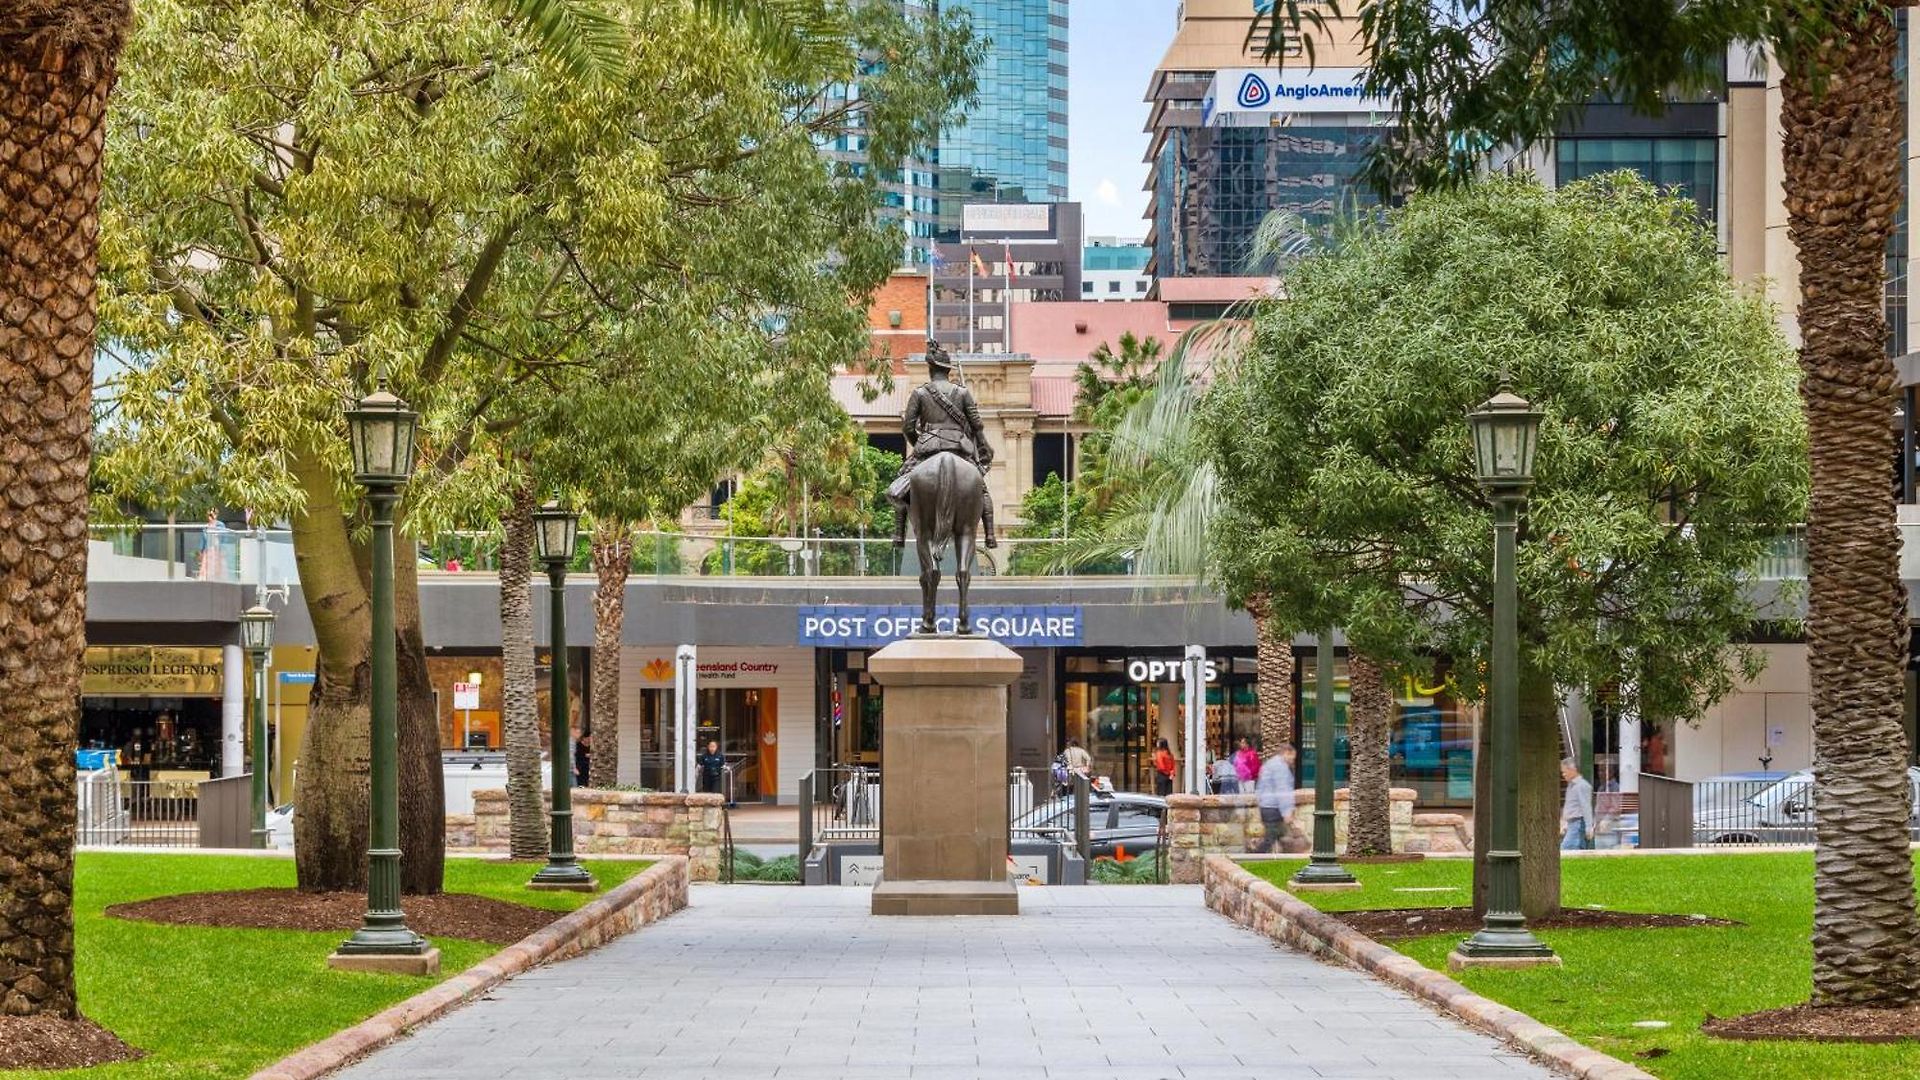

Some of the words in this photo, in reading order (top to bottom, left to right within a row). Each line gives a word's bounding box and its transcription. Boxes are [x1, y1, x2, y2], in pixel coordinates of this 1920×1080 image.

[805, 617, 865, 637] POST
[874, 617, 962, 637] OFFC
[976, 617, 1075, 637] SQUARE
[85, 664, 150, 675] ESPRESSO
[153, 664, 218, 675] LEGENDS
[740, 662, 778, 673] Country
[1128, 661, 1217, 682] OPTS
